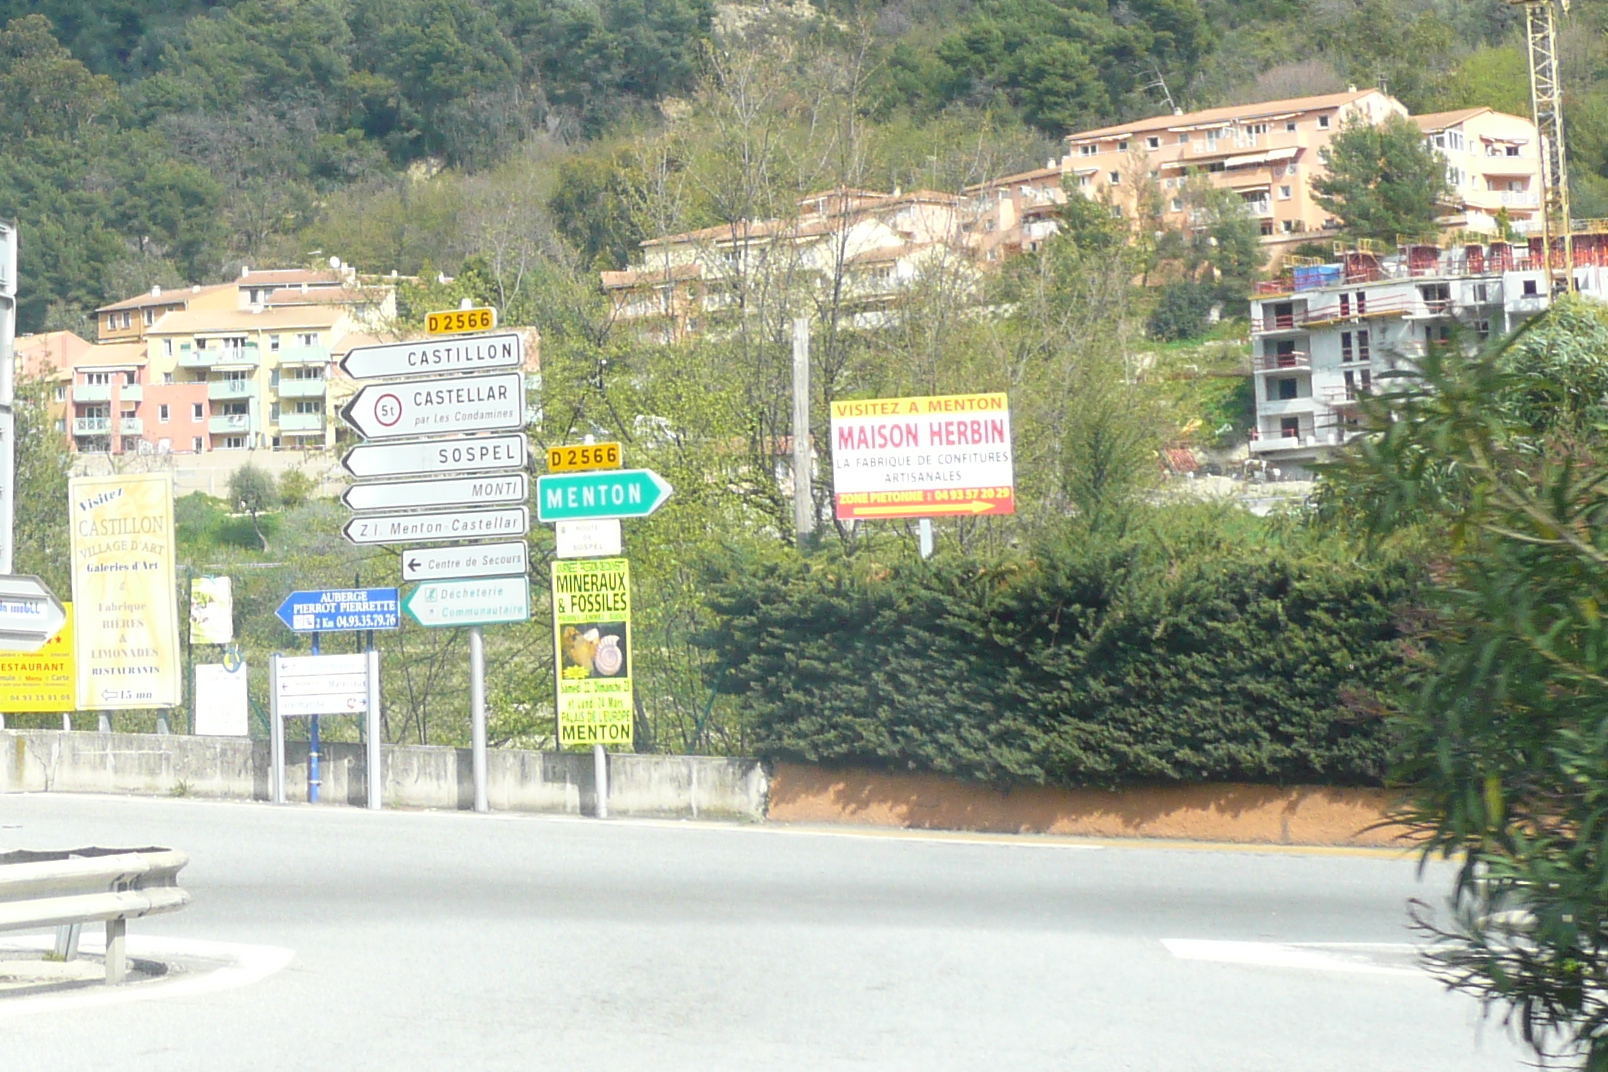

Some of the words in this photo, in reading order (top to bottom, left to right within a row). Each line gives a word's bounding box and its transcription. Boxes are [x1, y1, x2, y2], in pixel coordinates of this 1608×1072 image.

[429, 316, 438, 332] D
[443, 312, 490, 331] 2566
[408, 343, 512, 367] CASTILLON
[414, 385, 507, 407] CASTELLAR
[836, 402, 900, 417] VISITEZ
[909, 402, 919, 413] A
[928, 397, 1002, 412] MENTON
[415, 415, 430, 427] par
[434, 413, 450, 424] Les
[454, 409, 514, 422] Condamines
[838, 423, 919, 451] MAISON
[929, 419, 1005, 446] HERBIN
[439, 444, 514, 463] SOSPEL
[552, 451, 561, 466] D
[567, 447, 617, 465] 2566
[836, 458, 851, 469] LA
[856, 456, 911, 468] FABRIQUE
[918, 455, 932, 466] DE
[938, 451, 1009, 465] CONFITURES
[884, 470, 962, 483] ARTISANALES
[471, 482, 517, 497] MONTI
[546, 483, 641, 509] MENTON
[839, 493, 869, 504] ZONE
[870, 491, 924, 503] PIETONNE
[79, 487, 123, 512] Visitez
[78, 515, 164, 537] CASTILLON
[390, 516, 518, 535] Menton-Castellar
[80, 540, 128, 559] VILLAGE
[130, 540, 165, 556] D'ART
[86, 561, 129, 573] Galeries
[131, 560, 158, 571] d'Art
[428, 559, 461, 570] Centre
[465, 556, 477, 567] de
[482, 554, 521, 566] Secours
[556, 571, 626, 593] MINERAUX
[320, 591, 368, 602] AUBERGE
[558, 597, 566, 614] &
[570, 592, 627, 613] FOSSILES
[98, 601, 147, 614] Fabrique
[293, 603, 336, 614] PIERROT
[340, 601, 396, 613] PIERRETTE
[118, 633, 128, 644] &
[91, 647, 160, 659] LIMONADES
[92, 665, 161, 676] RESTAURANTS
[120, 690, 132, 700] 15
[562, 723, 630, 740] MENTON
